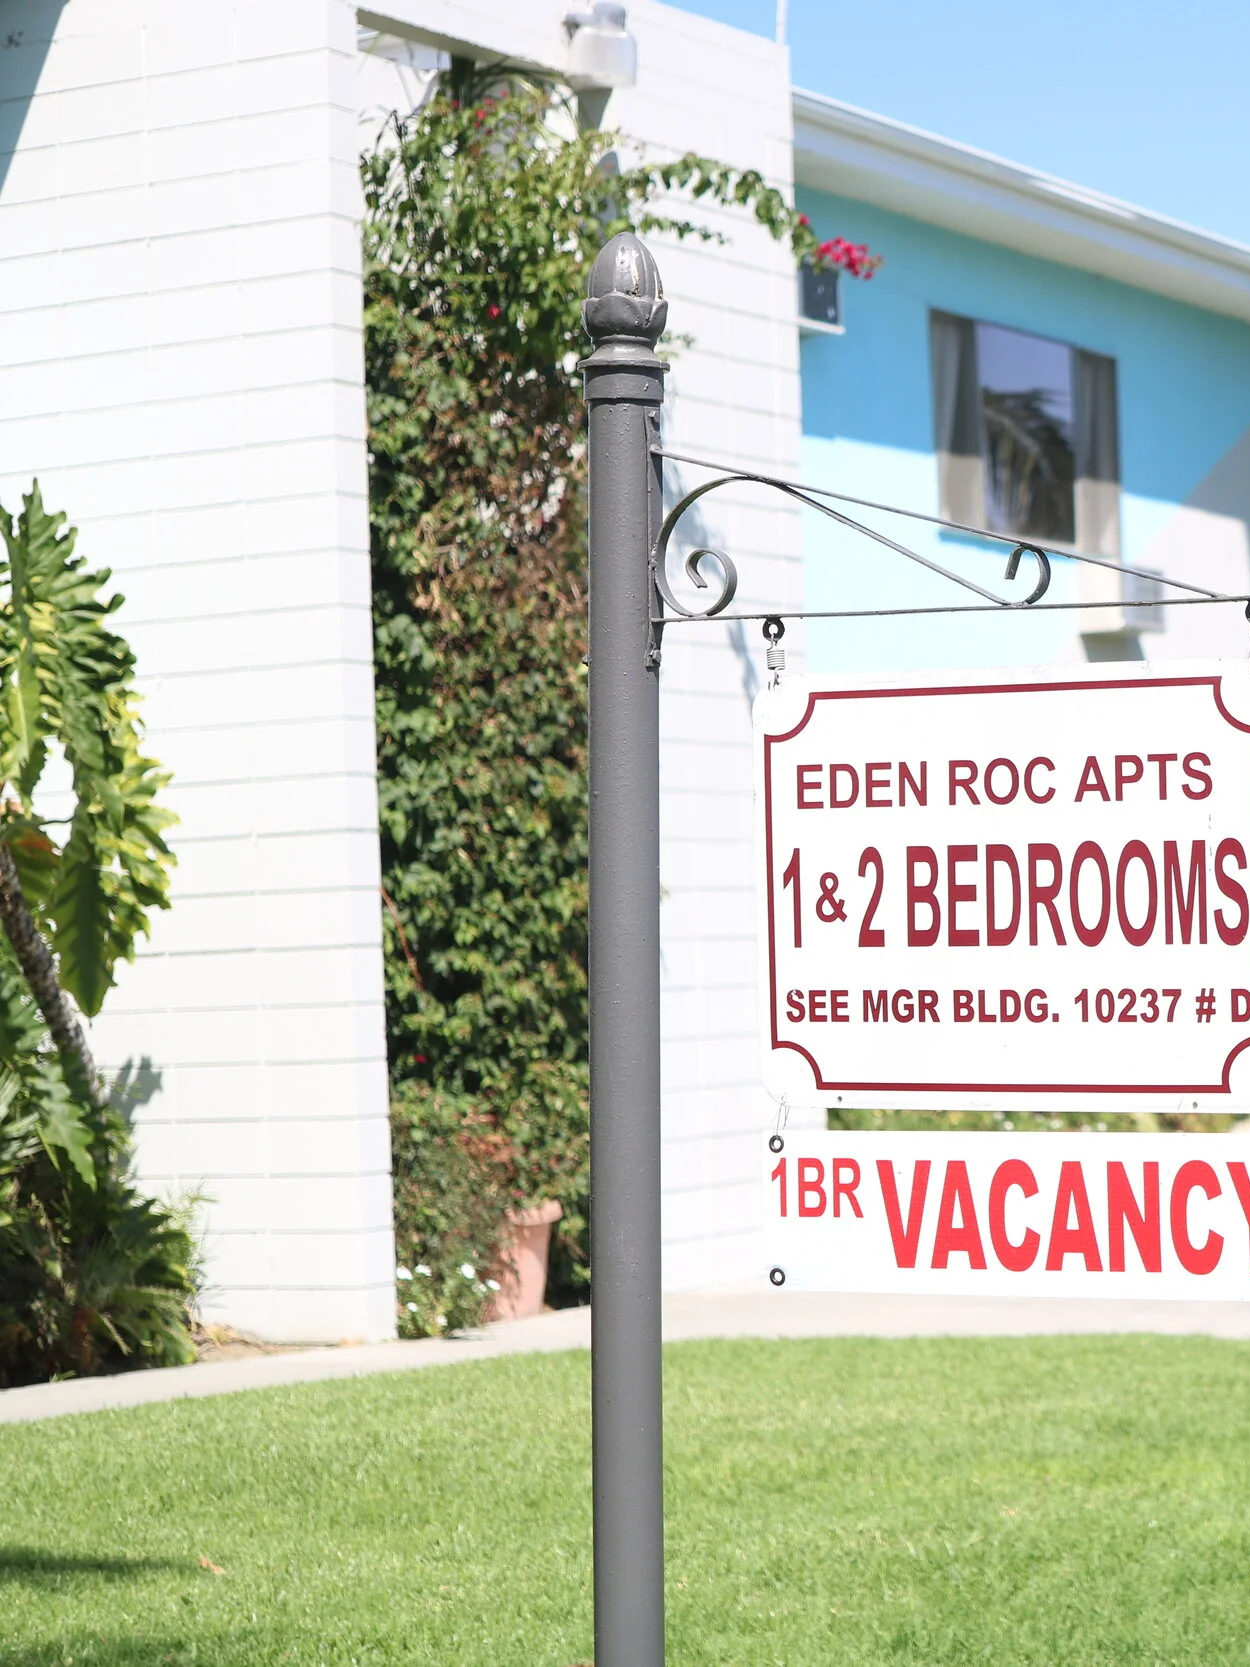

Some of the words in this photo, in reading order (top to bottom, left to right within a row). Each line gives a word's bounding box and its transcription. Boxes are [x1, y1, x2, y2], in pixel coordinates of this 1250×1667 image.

[797, 761, 927, 809] EDEN
[948, 756, 1056, 806] ROC
[1074, 751, 1213, 802] APTS
[783, 847, 802, 948] 1
[815, 871, 848, 923] &
[858, 846, 885, 948] 2
[906, 837, 1249, 948] BEDROOMS
[786, 988, 850, 1023] SEE
[863, 988, 940, 1023] MGR
[953, 988, 1059, 1023] BLDG.
[1074, 987, 1182, 1023] 10237
[1195, 988, 1217, 1023] #
[771, 1157, 864, 1219] 1BR
